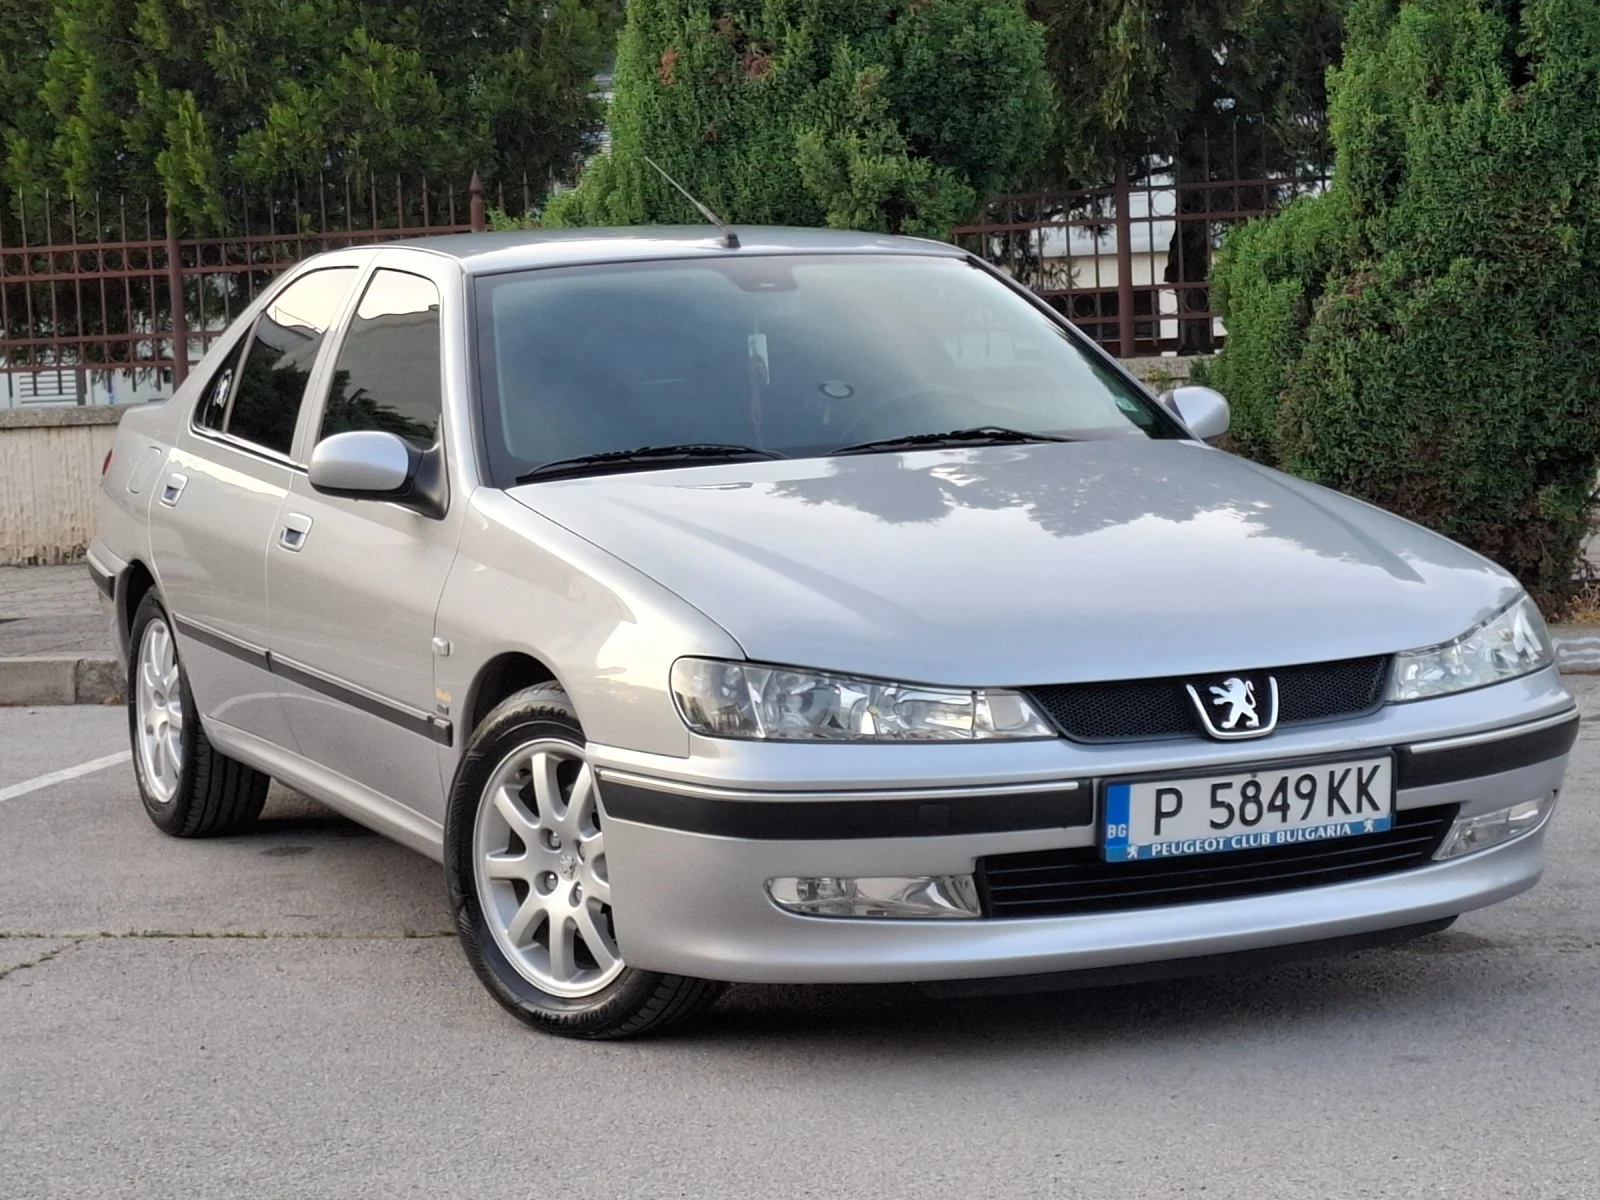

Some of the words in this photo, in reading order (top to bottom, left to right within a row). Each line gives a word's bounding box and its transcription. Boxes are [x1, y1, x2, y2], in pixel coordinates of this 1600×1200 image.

[1154, 787, 1183, 836] P
[1107, 824, 1127, 839] BG
[1151, 838, 1226, 857] PEUGEOT
[1231, 832, 1271, 849] CLUB
[1276, 823, 1351, 844] BULGARIA
